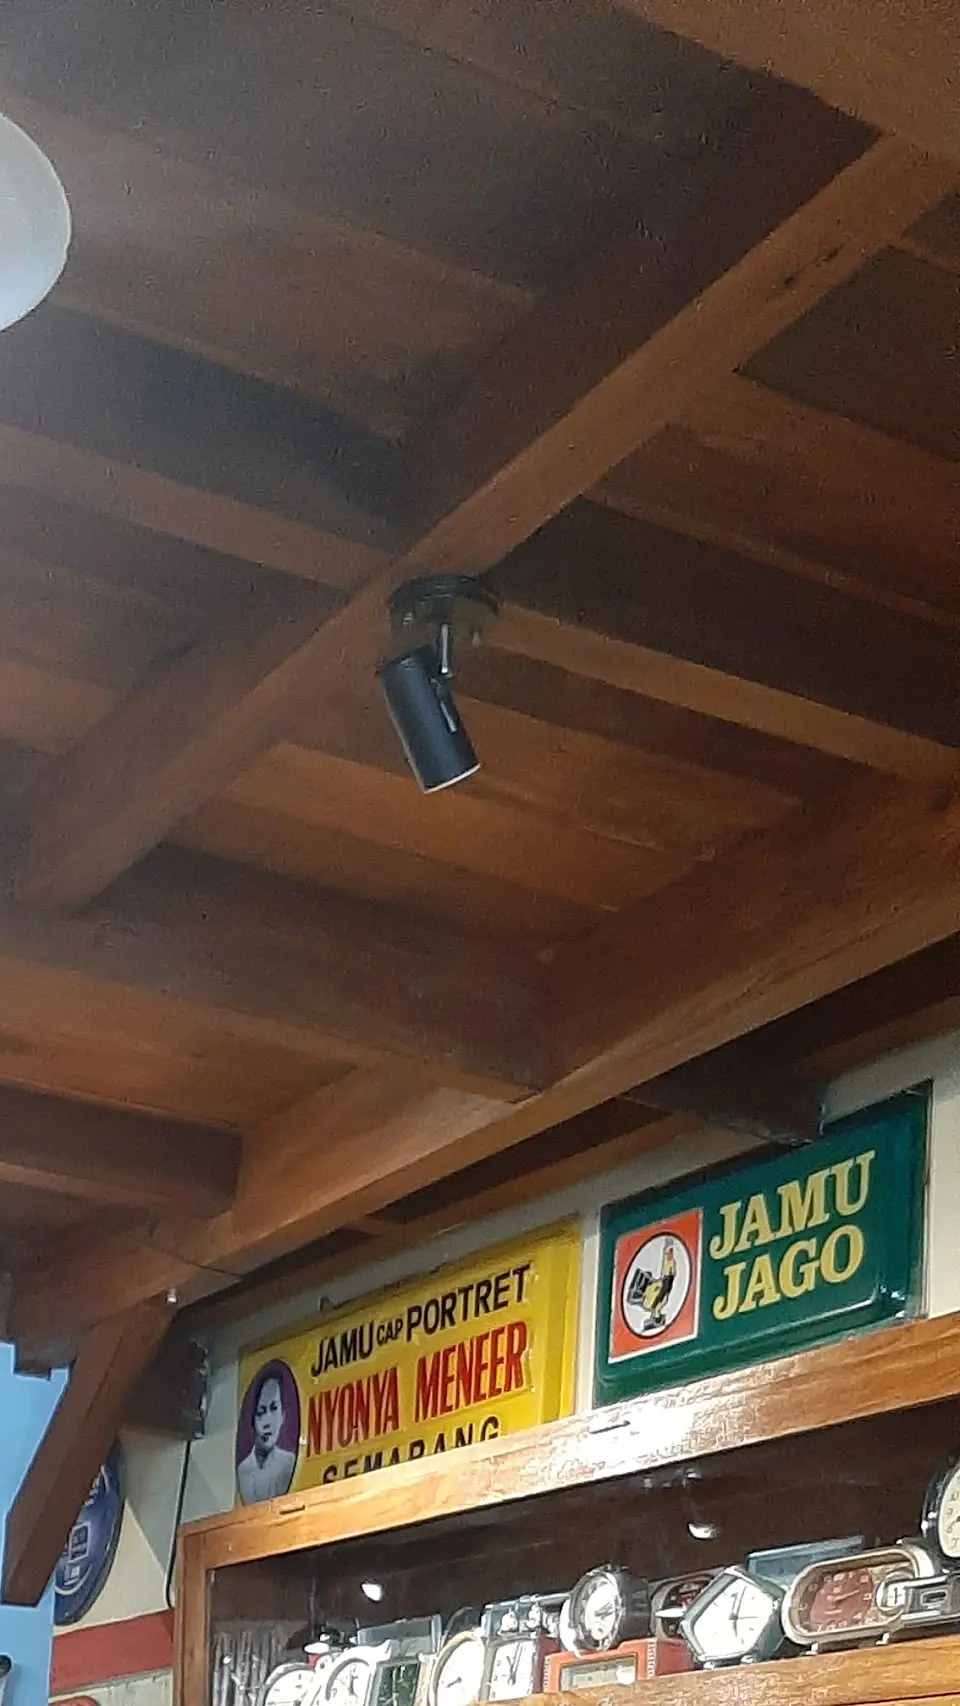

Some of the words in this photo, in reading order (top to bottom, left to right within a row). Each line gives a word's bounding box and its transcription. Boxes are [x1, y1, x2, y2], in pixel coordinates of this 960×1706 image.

[709, 1150, 876, 1260] JAMU
[311, 1320, 375, 1377] JAMU
[377, 1318, 403, 1346] CAP
[406, 1262, 531, 1341] PORTRET
[713, 1225, 864, 1320] JAGO
[306, 1367, 400, 1457] NYONYA
[415, 1320, 528, 1423] MENEER
